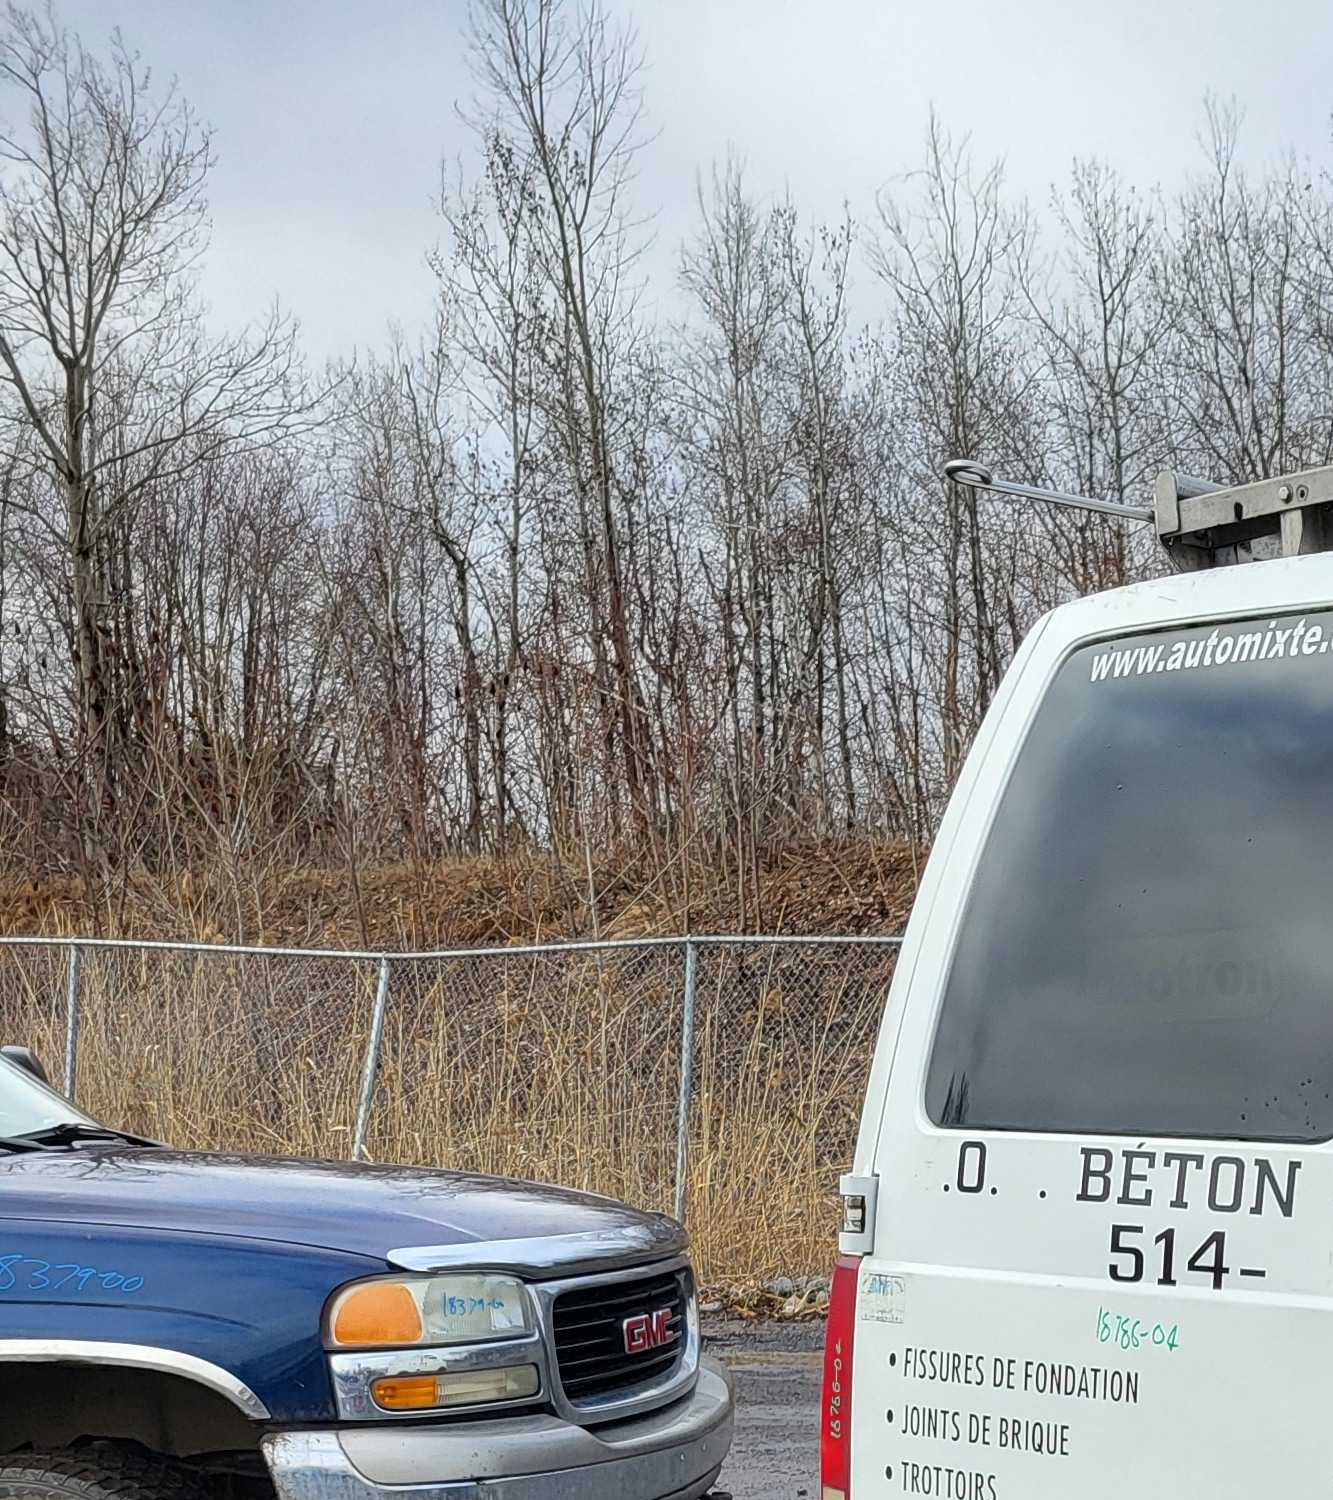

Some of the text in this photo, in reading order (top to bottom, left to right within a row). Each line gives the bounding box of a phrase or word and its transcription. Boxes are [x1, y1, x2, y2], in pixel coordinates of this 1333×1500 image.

[1076, 1142, 1301, 1219] BÉTON
[623, 1308, 674, 1354] GMC
[904, 1348, 1139, 1403] FISSURES DE FONDATION
[901, 1405, 1071, 1457] JOINTS DE BRIQUE
